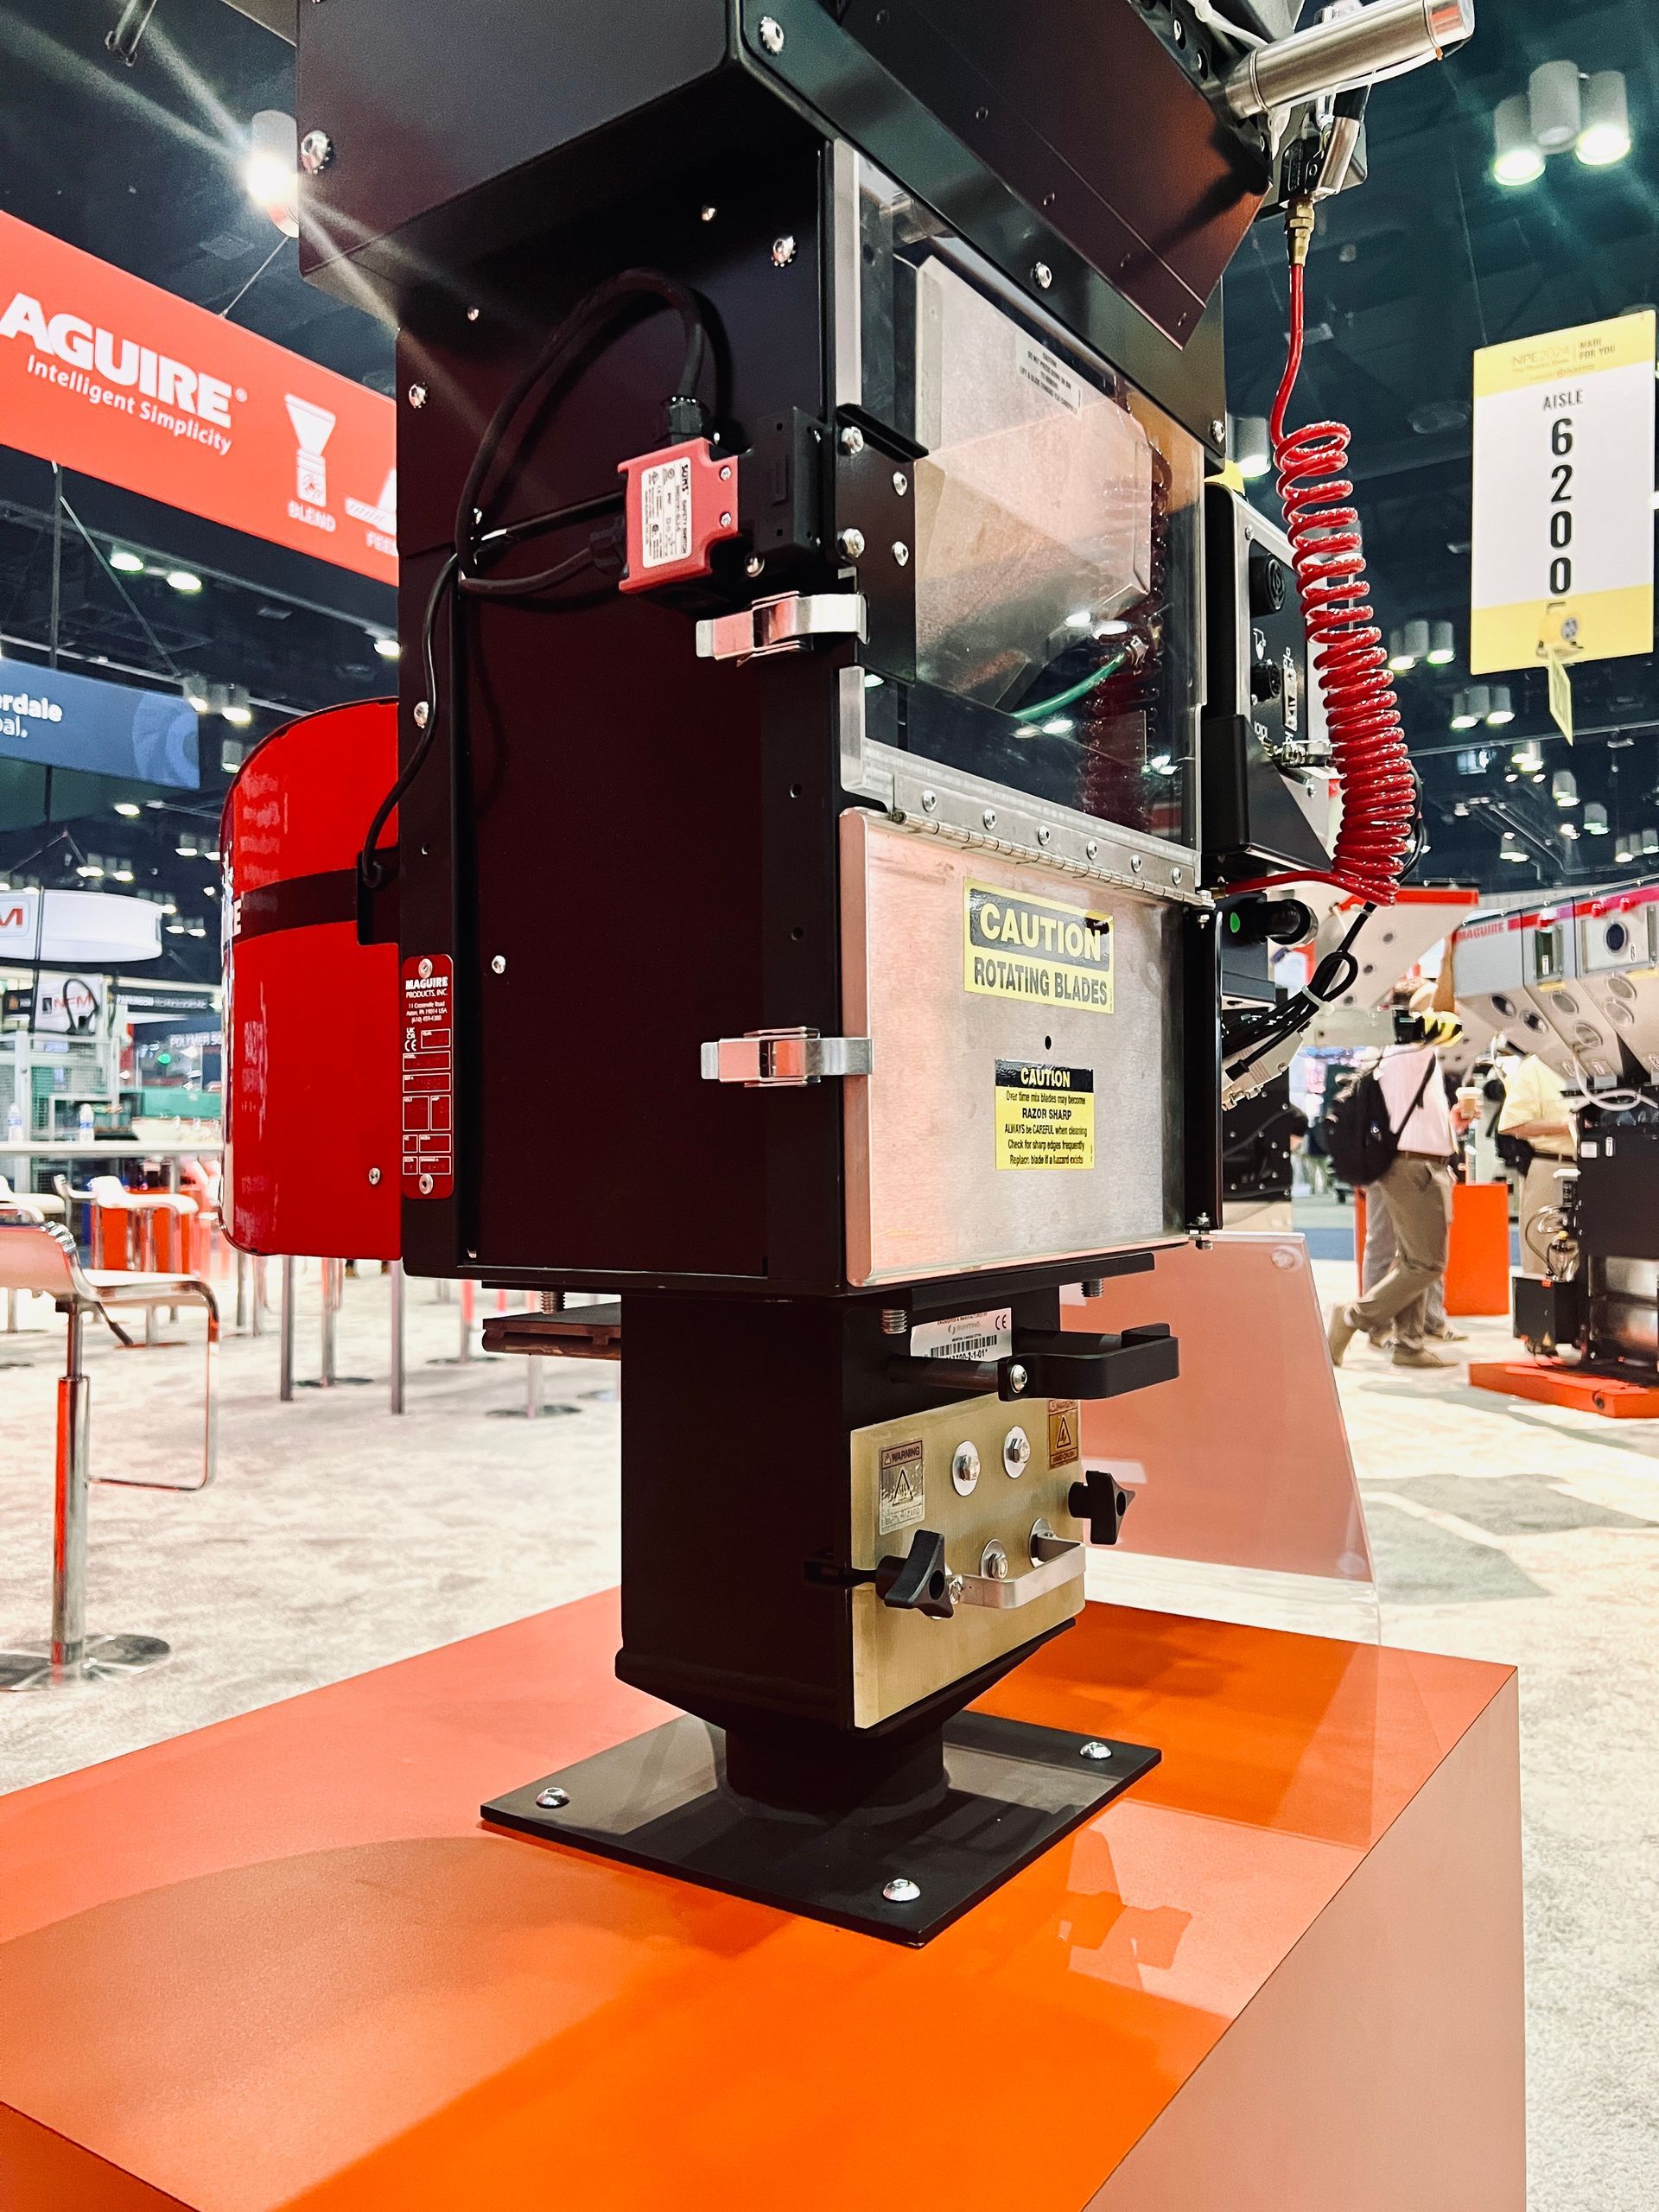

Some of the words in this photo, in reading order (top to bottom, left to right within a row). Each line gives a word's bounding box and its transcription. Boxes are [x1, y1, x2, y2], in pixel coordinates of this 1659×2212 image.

[1580, 349, 1596, 360] FOR
[1599, 345, 1616, 355] YOU
[27, 354, 135, 415] Intelligent
[139, 400, 232, 456] Simplicity
[1542, 390, 1584, 411] AISLE
[288, 499, 336, 532] BLEND
[0, 693, 63, 722] rdale
[980, 903, 1102, 963] CAUTION
[1455, 922, 1504, 943] MAGUIRE
[405, 976, 448, 990] MAGUIRE
[974, 957, 1050, 997] ROTATING
[1054, 975, 1109, 1007] BLADES
[1020, 1067, 1071, 1089] CAUTION
[1007, 1090, 1018, 1101] Over
[1019, 1091, 1030, 1102] time
[1031, 1092, 1039, 1103] mix
[1040, 1093, 1056, 1103] blades
[1057, 1096, 1067, 1106] may
[1068, 1096, 1086, 1105] become
[1022, 1108, 1047, 1119] RAZOR
[1048, 1109, 1072, 1121] SHARP
[1004, 1123, 1025, 1134] ALWAYS
[1026, 1125, 1032, 1135] be
[1033, 1124, 1054, 1135] CAREFUL
[1055, 1125, 1068, 1135] when
[1068, 1126, 1088, 1137] cleaning
[1007, 1139, 1023, 1149] Check
[1033, 1140, 1046, 1151] sharp
[1047, 1141, 1061, 1151] edges
[1062, 1140, 1085, 1152] frequently
[1009, 1154, 1029, 1166] Replace
[1031, 1155, 1044, 1165] blade
[1052, 1155, 1070, 1165] hazard
[1070, 1155, 1084, 1164] exists
[891, 1446, 920, 1463] WARNING
